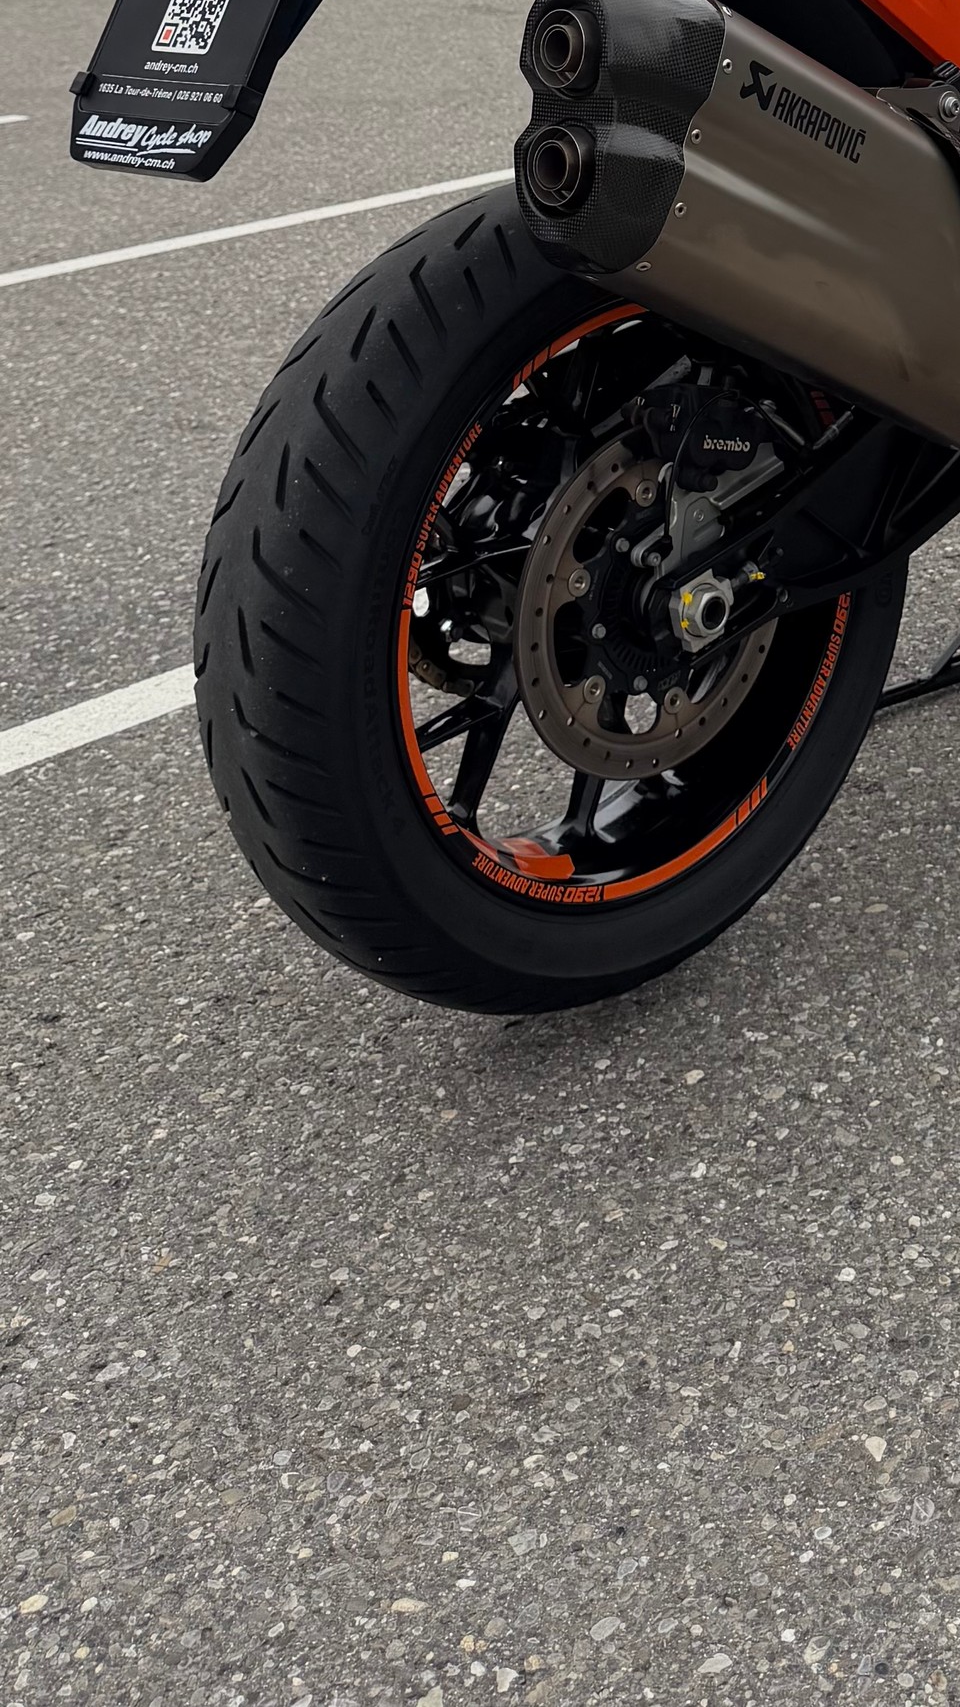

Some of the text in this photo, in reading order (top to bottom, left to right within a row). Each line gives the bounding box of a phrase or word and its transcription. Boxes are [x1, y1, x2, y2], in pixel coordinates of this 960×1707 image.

[144, 59, 199, 74] andrey-cm.ch
[98, 82, 114, 94] 1635
[114, 85, 124, 94] La
[189, 91, 203, 101] 921
[79, 114, 212, 150] Andrey Cycle shop
[83, 149, 176, 169] www.andrey-cm.ch
[703, 434, 751, 452] brembo
[402, 420, 483, 606] 1290 SUPER ADVENTURE
[786, 590, 852, 751] 290 SUPER ADVENTURE
[471, 851, 603, 903] 1290 SUPER ADVENTURE
